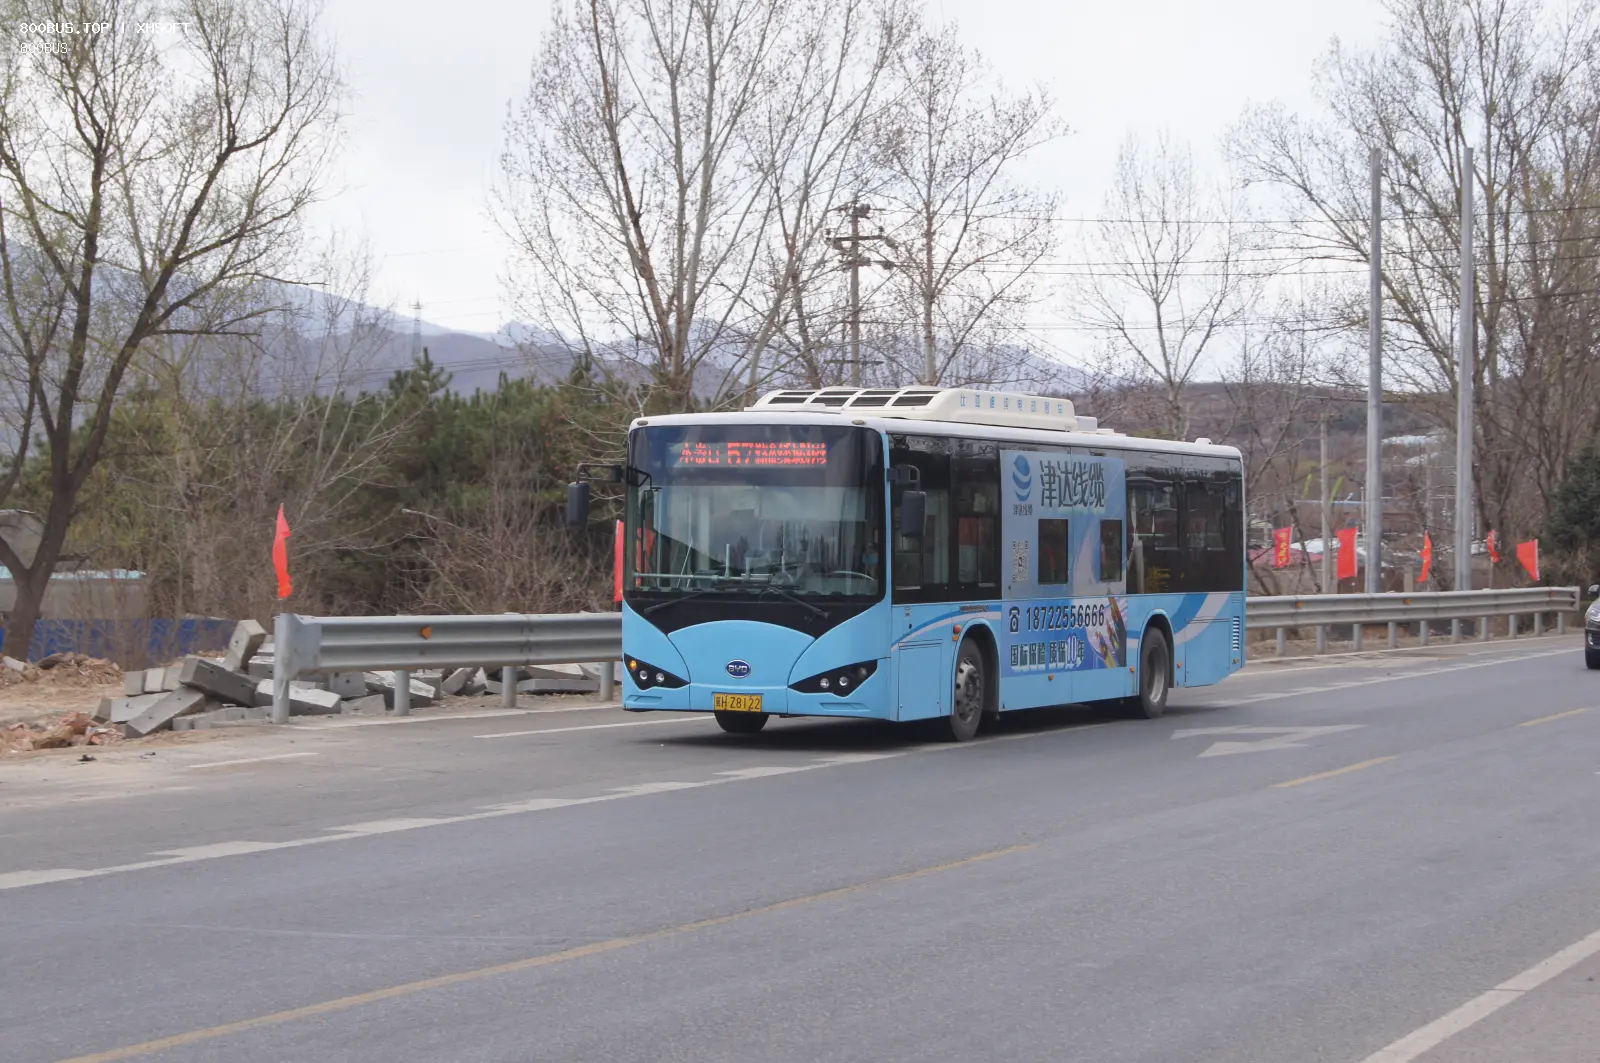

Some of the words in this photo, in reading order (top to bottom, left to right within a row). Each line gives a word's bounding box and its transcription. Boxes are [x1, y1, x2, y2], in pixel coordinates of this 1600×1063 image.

[1039, 459, 1105, 508] 津达线缆
[1026, 603, 1105, 632] 18722556666
[728, 664, 748, 673] BYD
